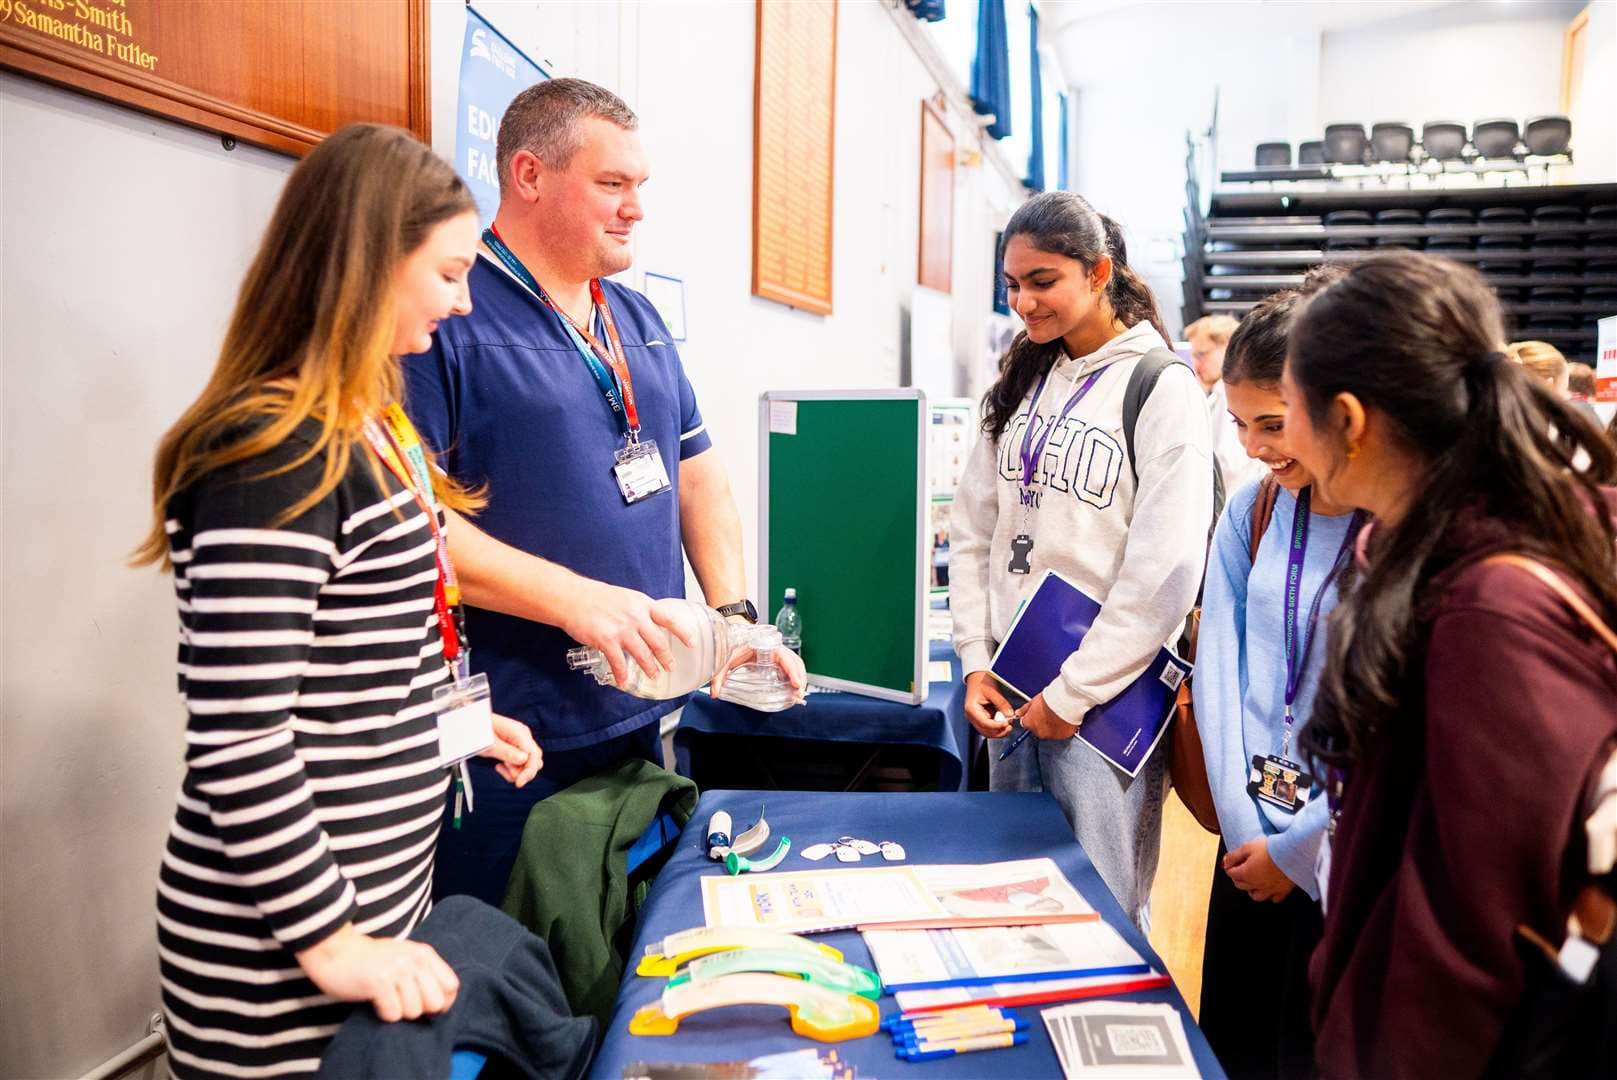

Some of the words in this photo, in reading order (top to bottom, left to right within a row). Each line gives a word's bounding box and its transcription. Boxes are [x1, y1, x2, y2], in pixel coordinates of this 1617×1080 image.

[14, 1, 103, 53] Samantha
[106, 33, 159, 71] Fuller
[605, 389, 621, 412] BMA
[1289, 563, 1299, 585] FORM
[1288, 585, 1297, 608] SIXTH
